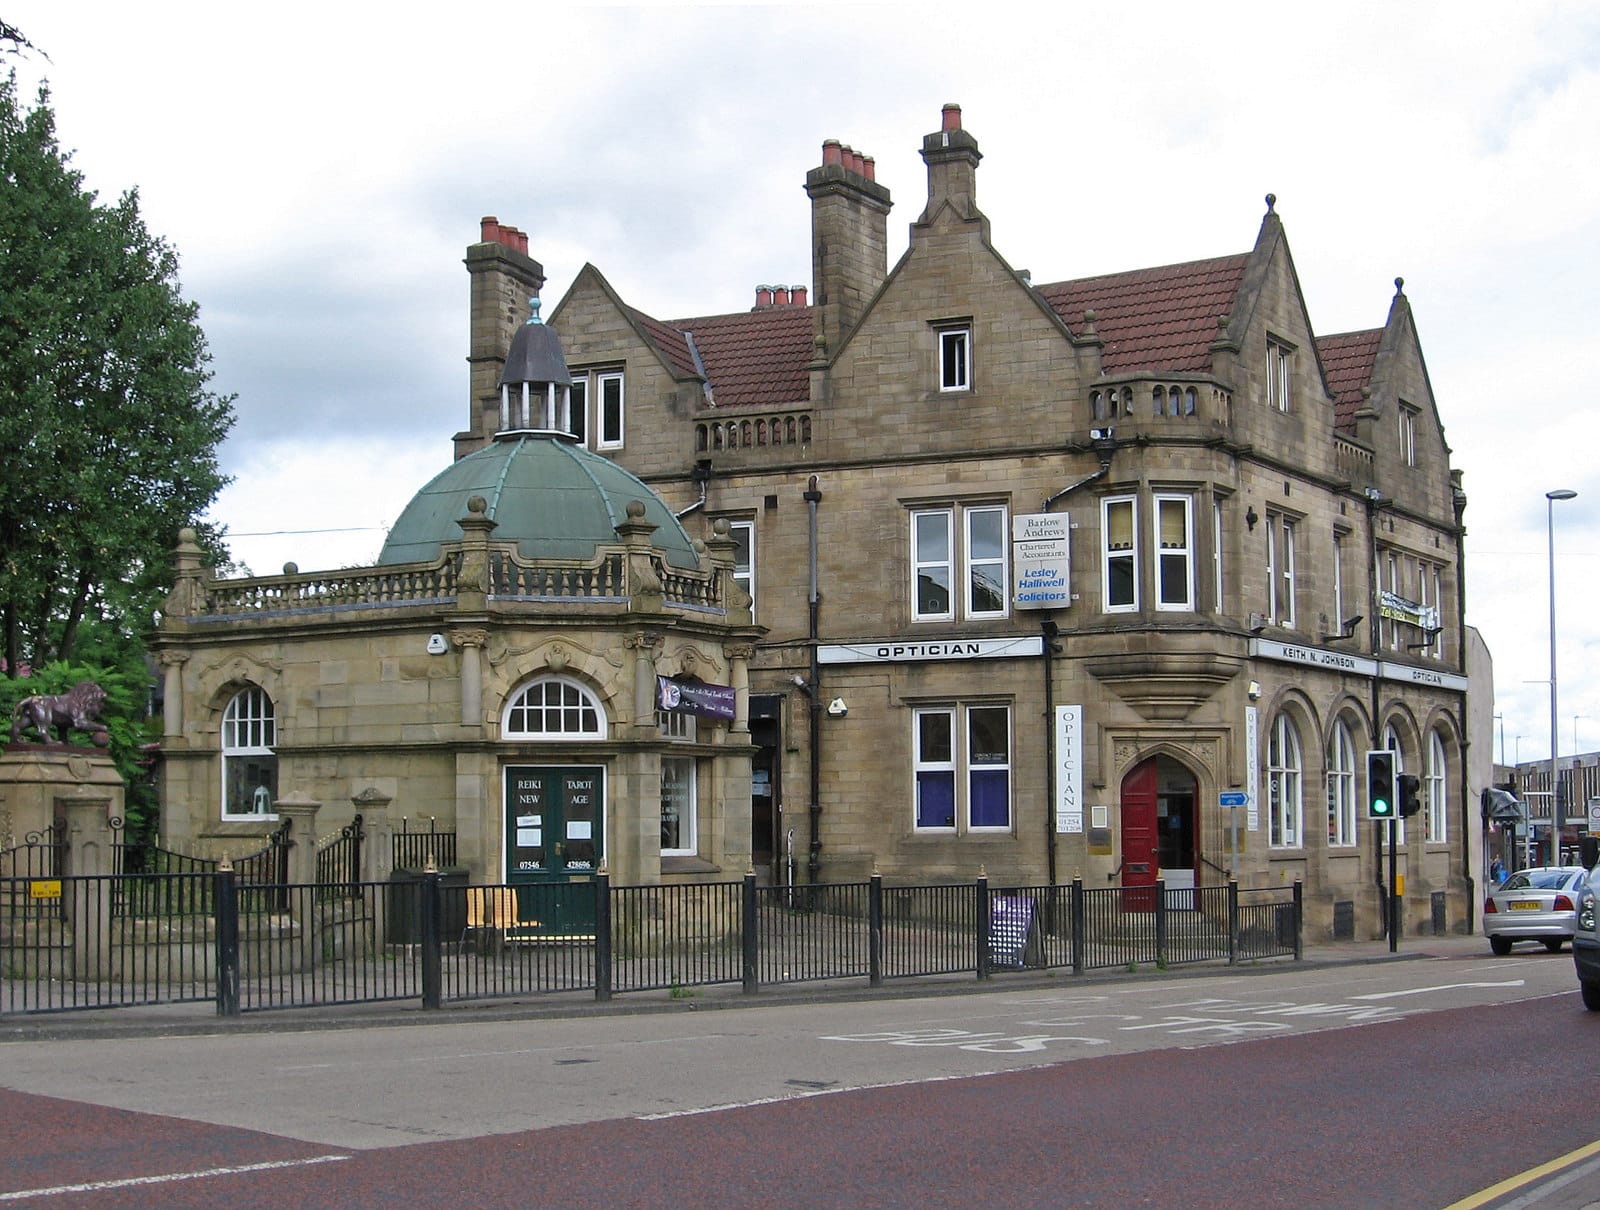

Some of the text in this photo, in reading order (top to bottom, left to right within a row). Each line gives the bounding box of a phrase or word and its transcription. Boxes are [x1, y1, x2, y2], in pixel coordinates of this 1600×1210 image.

[1027, 518, 1059, 527] Barlow
[1024, 528, 1065, 537] Andrews
[1020, 542, 1056, 551] Chartered
[1022, 551, 1065, 559] Accountants
[1024, 568, 1057, 578] Lesley
[1018, 578, 1065, 588] Halliwell
[1017, 592, 1066, 601] Solicitors
[877, 644, 980, 657] OPTICIAN
[1282, 647, 1307, 660] KEITH
[1321, 655, 1356, 669] JOHNSON
[1412, 671, 1442, 685] OPTICIAN
[1063, 712, 1075, 806] OPTICIAN
[518, 780, 592, 789] REIKI TAROT
[519, 795, 589, 804] NEW AGE
[817, 1028, 1111, 1053] BUS
